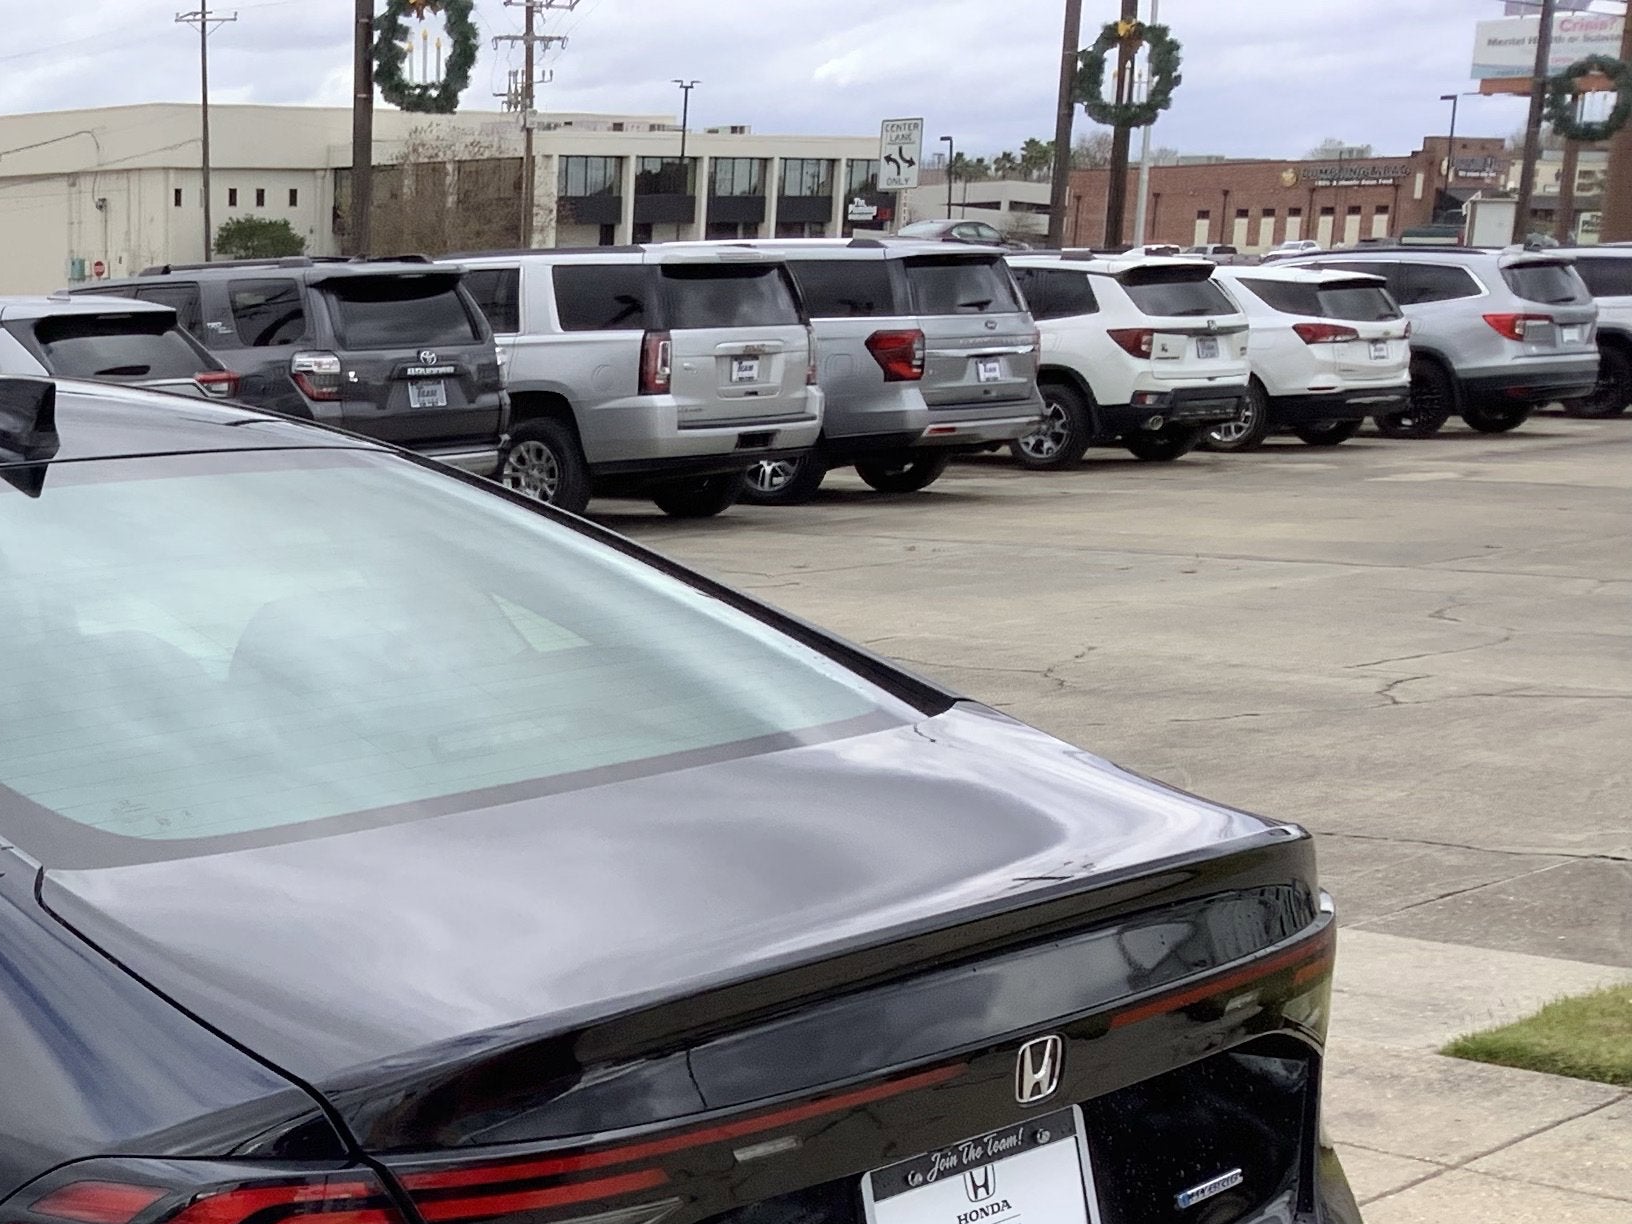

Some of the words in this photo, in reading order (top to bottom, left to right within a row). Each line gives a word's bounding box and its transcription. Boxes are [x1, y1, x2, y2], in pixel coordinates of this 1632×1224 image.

[885, 122, 919, 133] CENTER
[889, 133, 913, 142] LANE
[886, 176, 910, 187] ONLY
[927, 1151, 959, 1182] Join
[959, 1142, 983, 1165] The
[984, 1127, 1024, 1156] Team!
